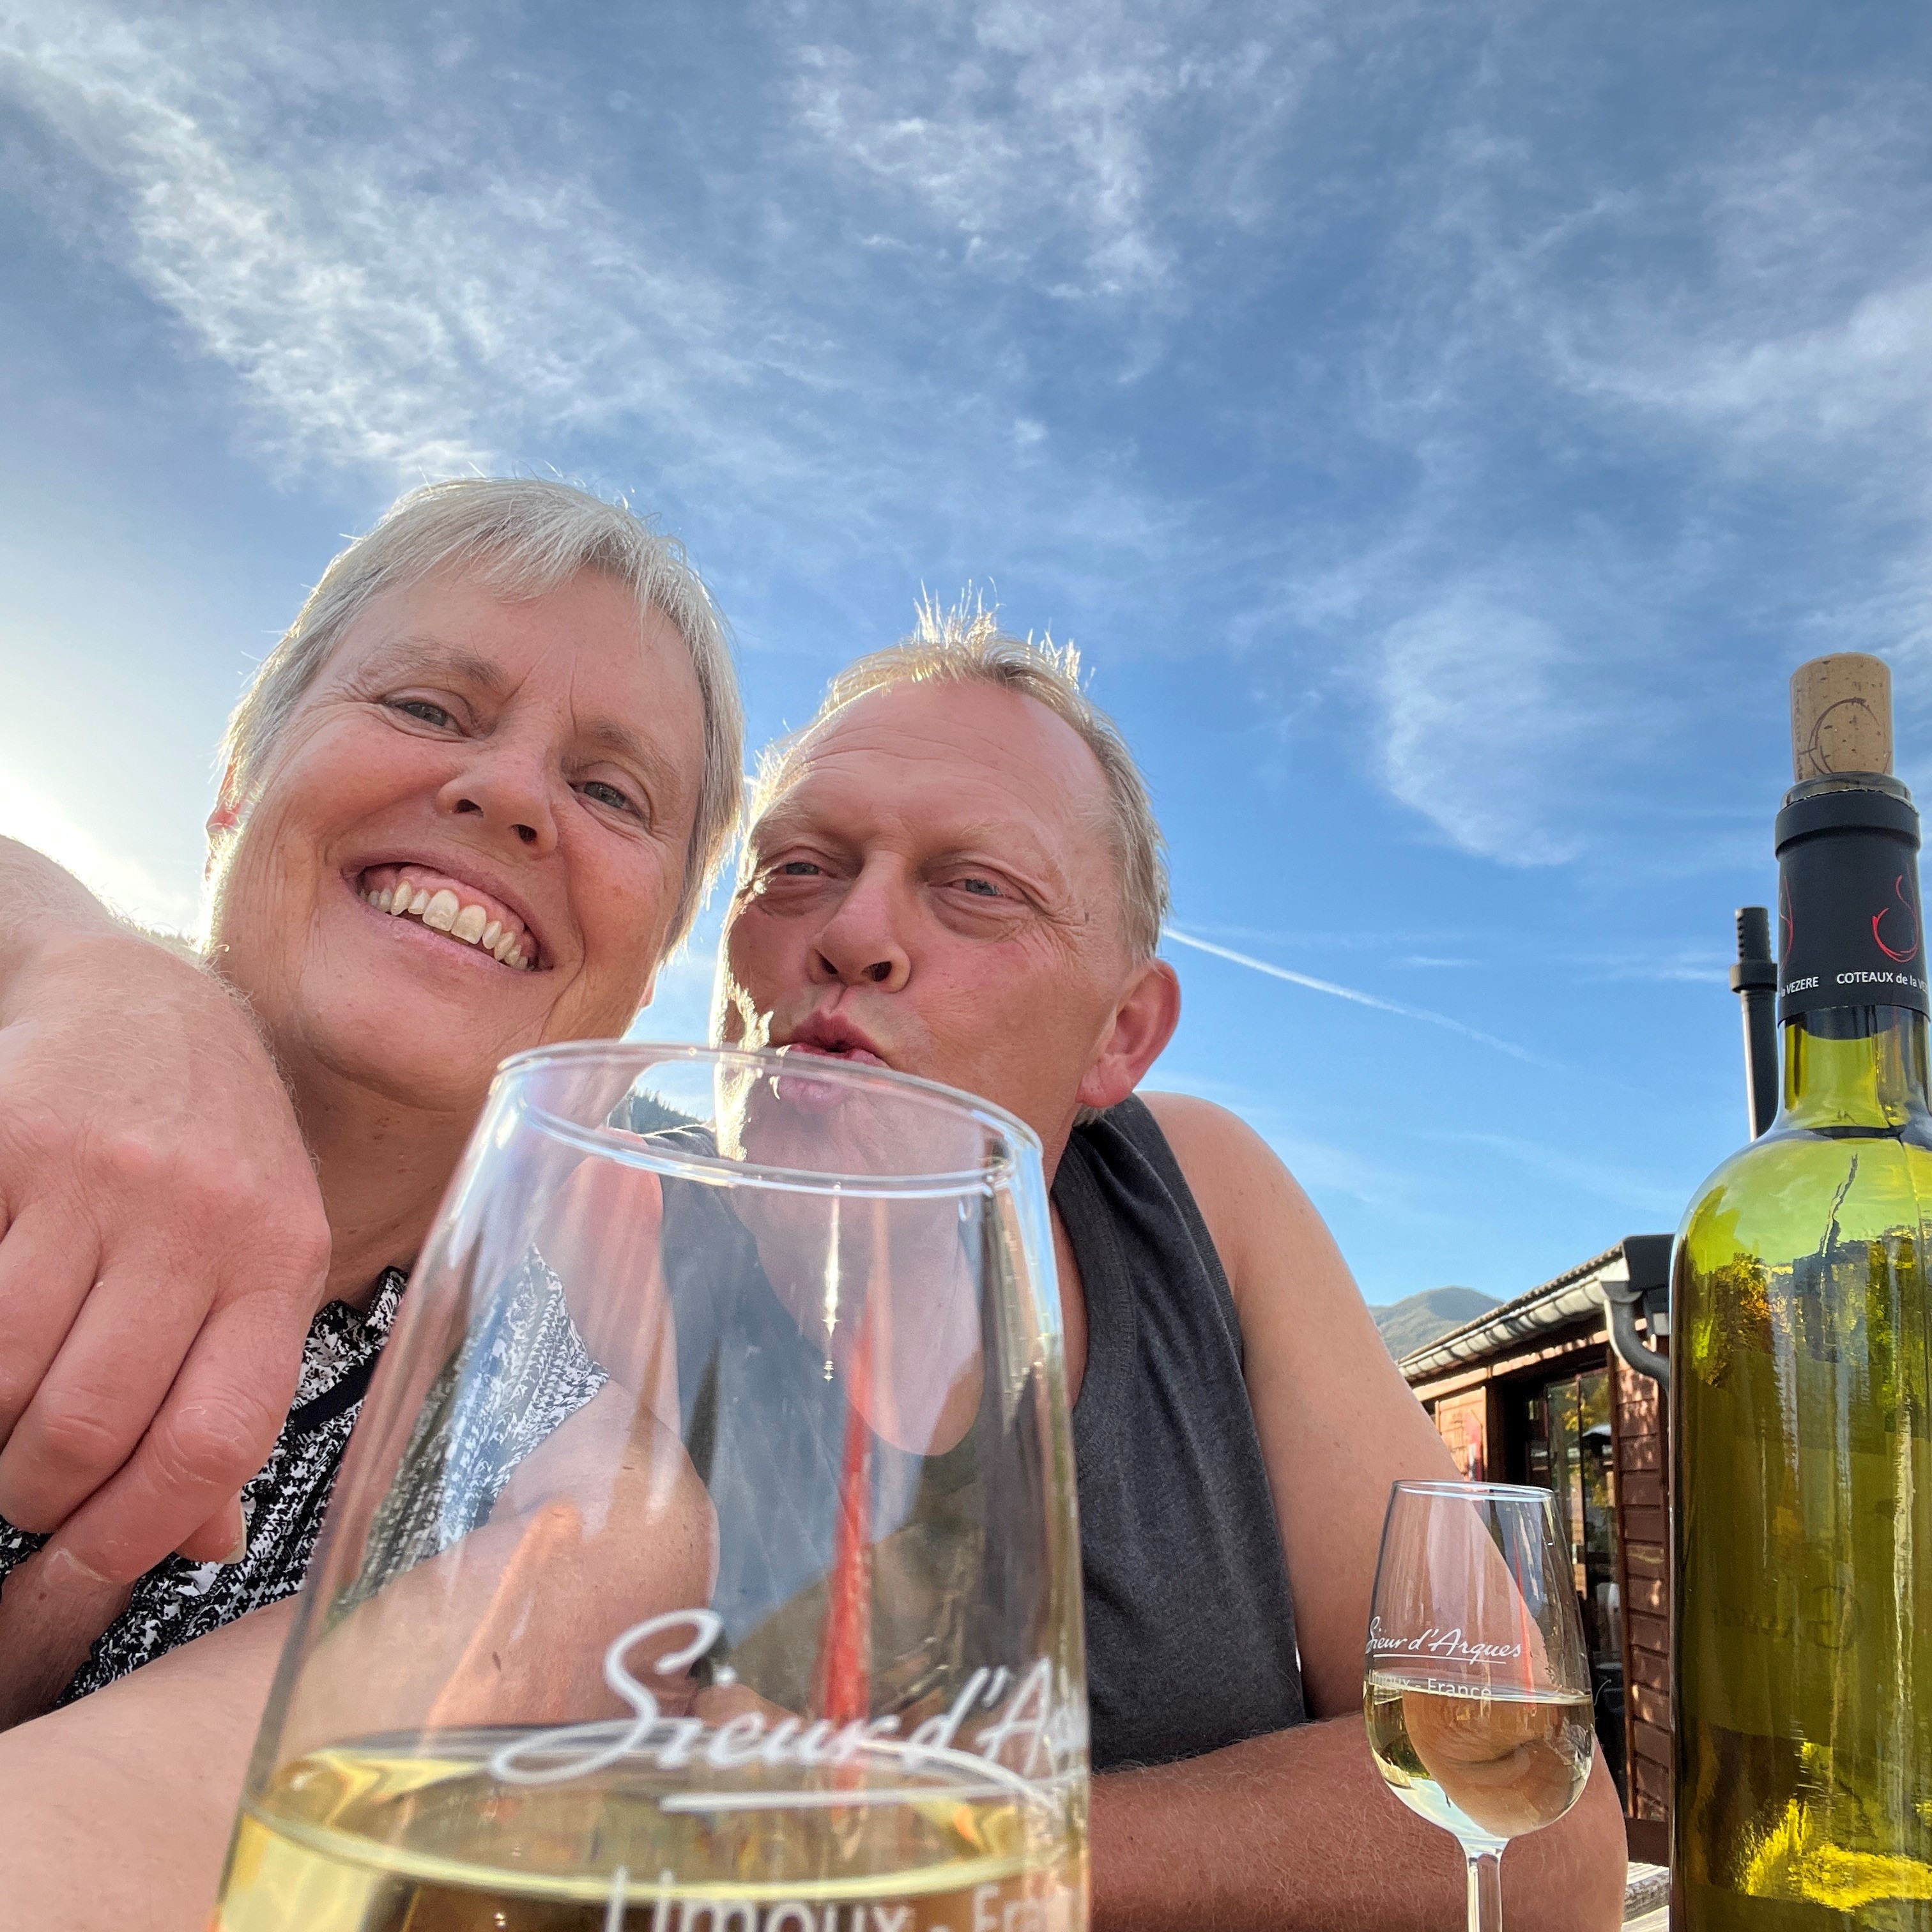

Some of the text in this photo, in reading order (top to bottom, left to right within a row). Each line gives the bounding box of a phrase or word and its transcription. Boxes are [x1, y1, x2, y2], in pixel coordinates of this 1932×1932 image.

[1786, 976, 1820, 995] VEZERE
[1836, 971, 1894, 985] COTEAUX
[1896, 972, 1908, 986] de
[1910, 974, 1917, 988] la
[1365, 1615, 1522, 1666] Sieur d'Arques
[487, 1607, 901, 1784] Sieur
[1427, 1677, 1492, 1698] France
